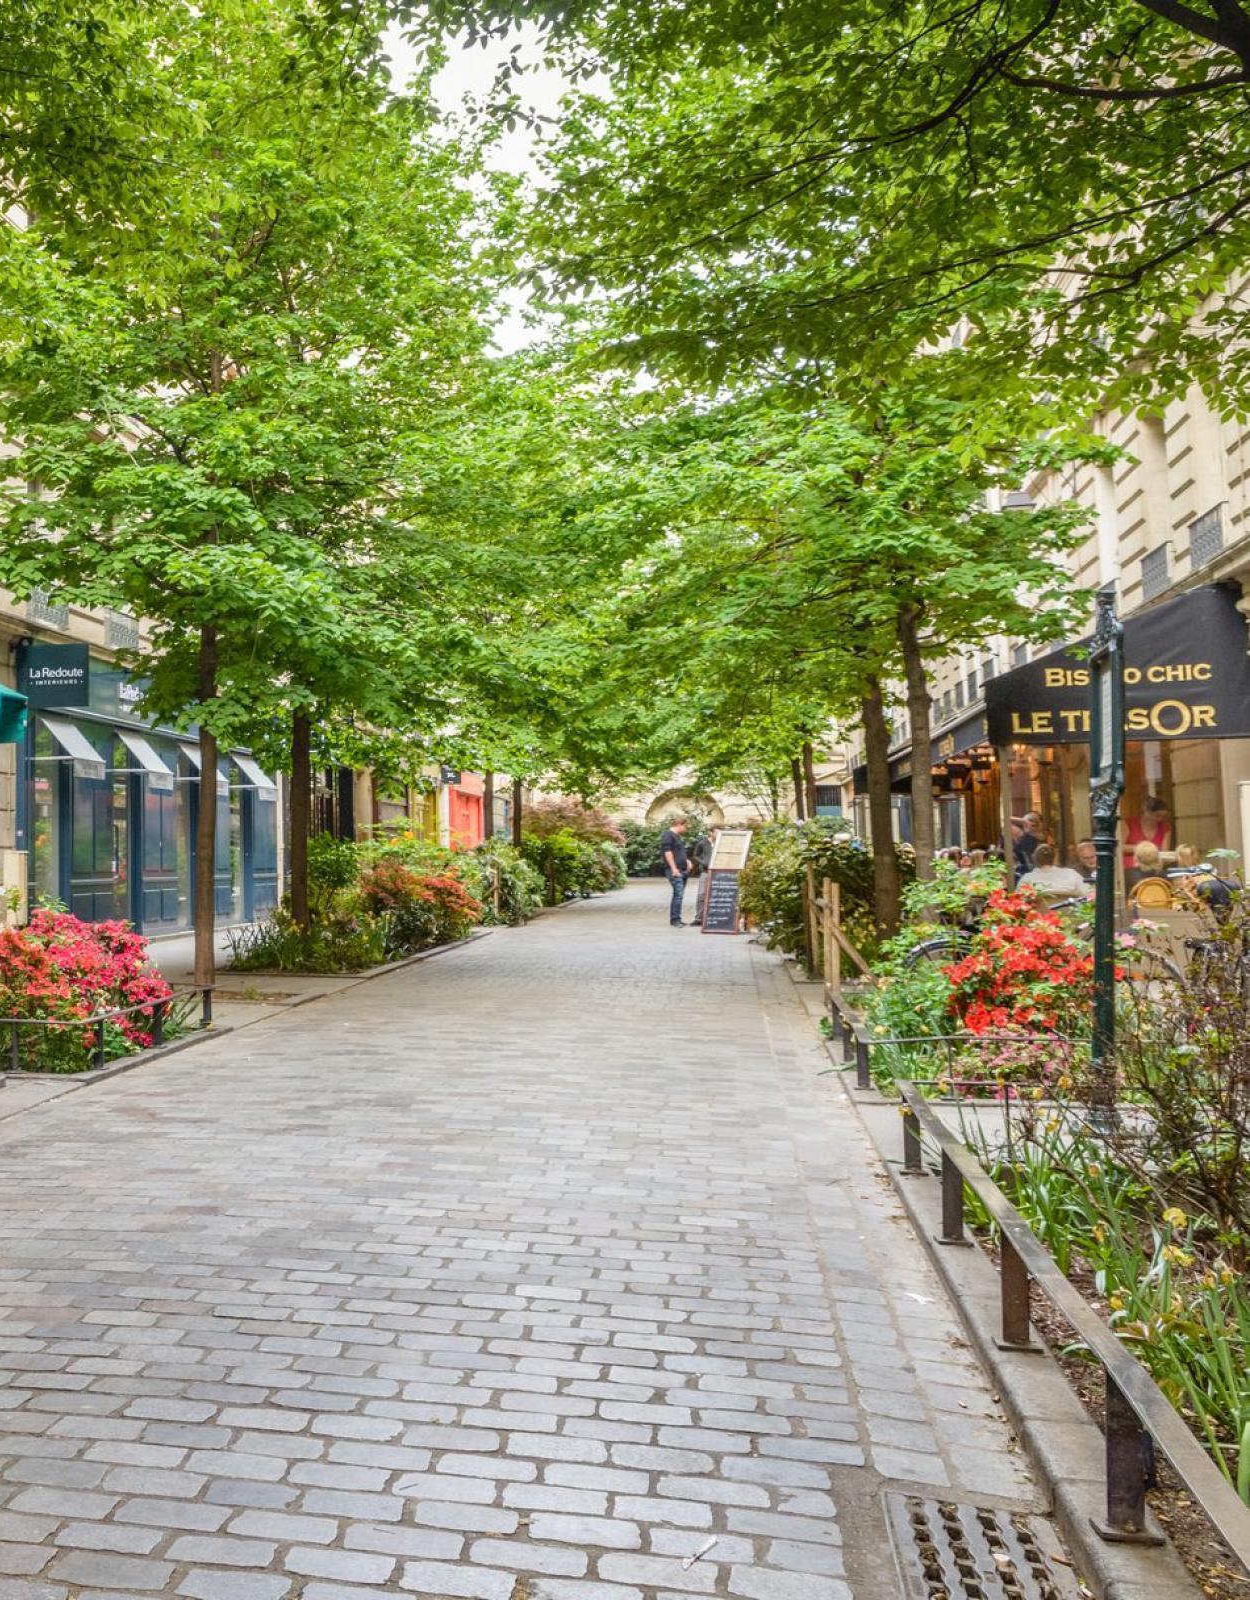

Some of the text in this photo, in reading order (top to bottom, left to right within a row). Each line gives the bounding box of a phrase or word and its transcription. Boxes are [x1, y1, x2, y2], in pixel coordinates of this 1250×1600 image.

[30, 666, 83, 678] La Redoute
[1011, 699, 1218, 735] LE TSOR
